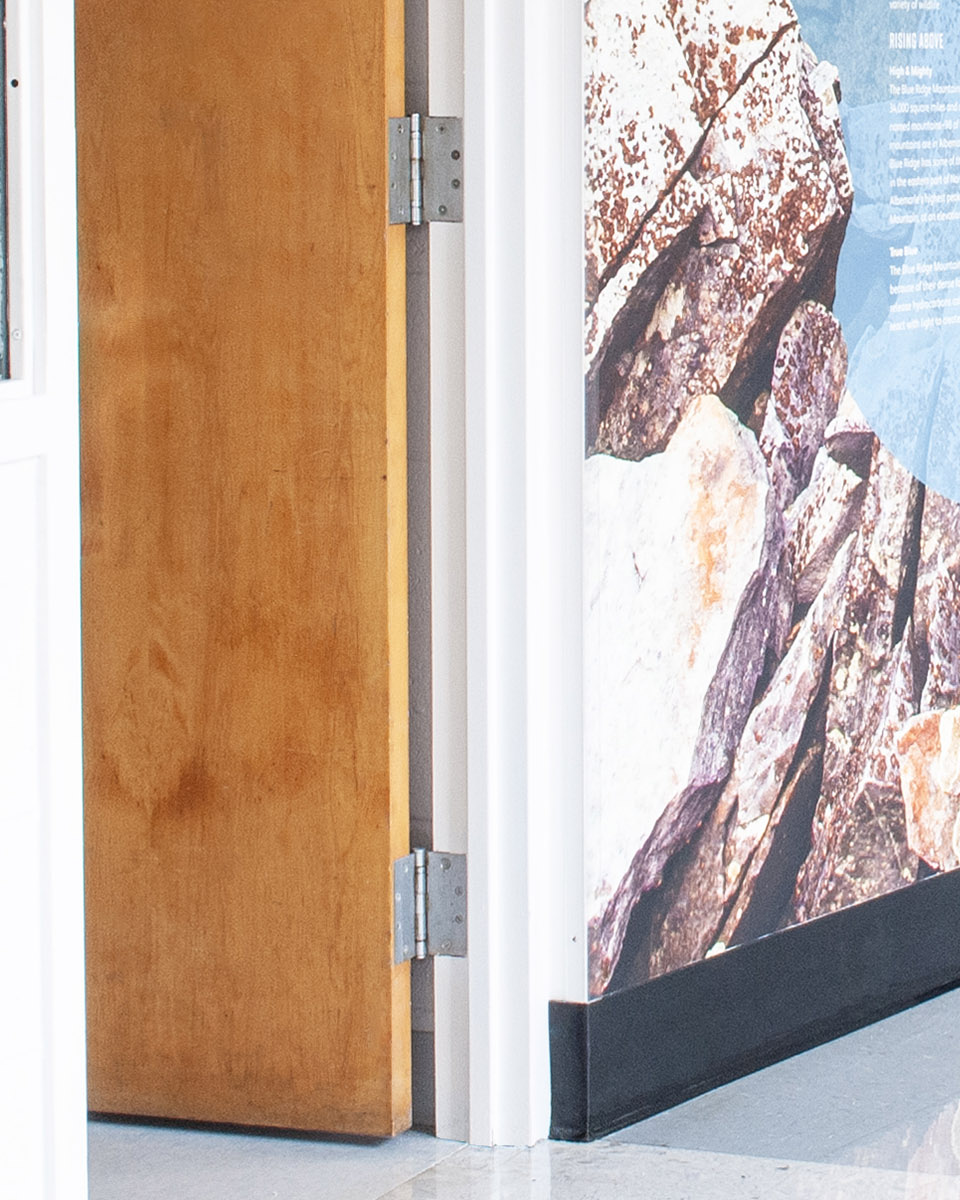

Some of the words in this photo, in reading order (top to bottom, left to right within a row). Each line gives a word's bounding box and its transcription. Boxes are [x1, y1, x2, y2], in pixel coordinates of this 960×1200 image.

[889, 0, 910, 11] variety
[911, 0, 918, 10] of
[890, 33, 917, 48] RISING
[919, 33, 944, 49] ABOVE
